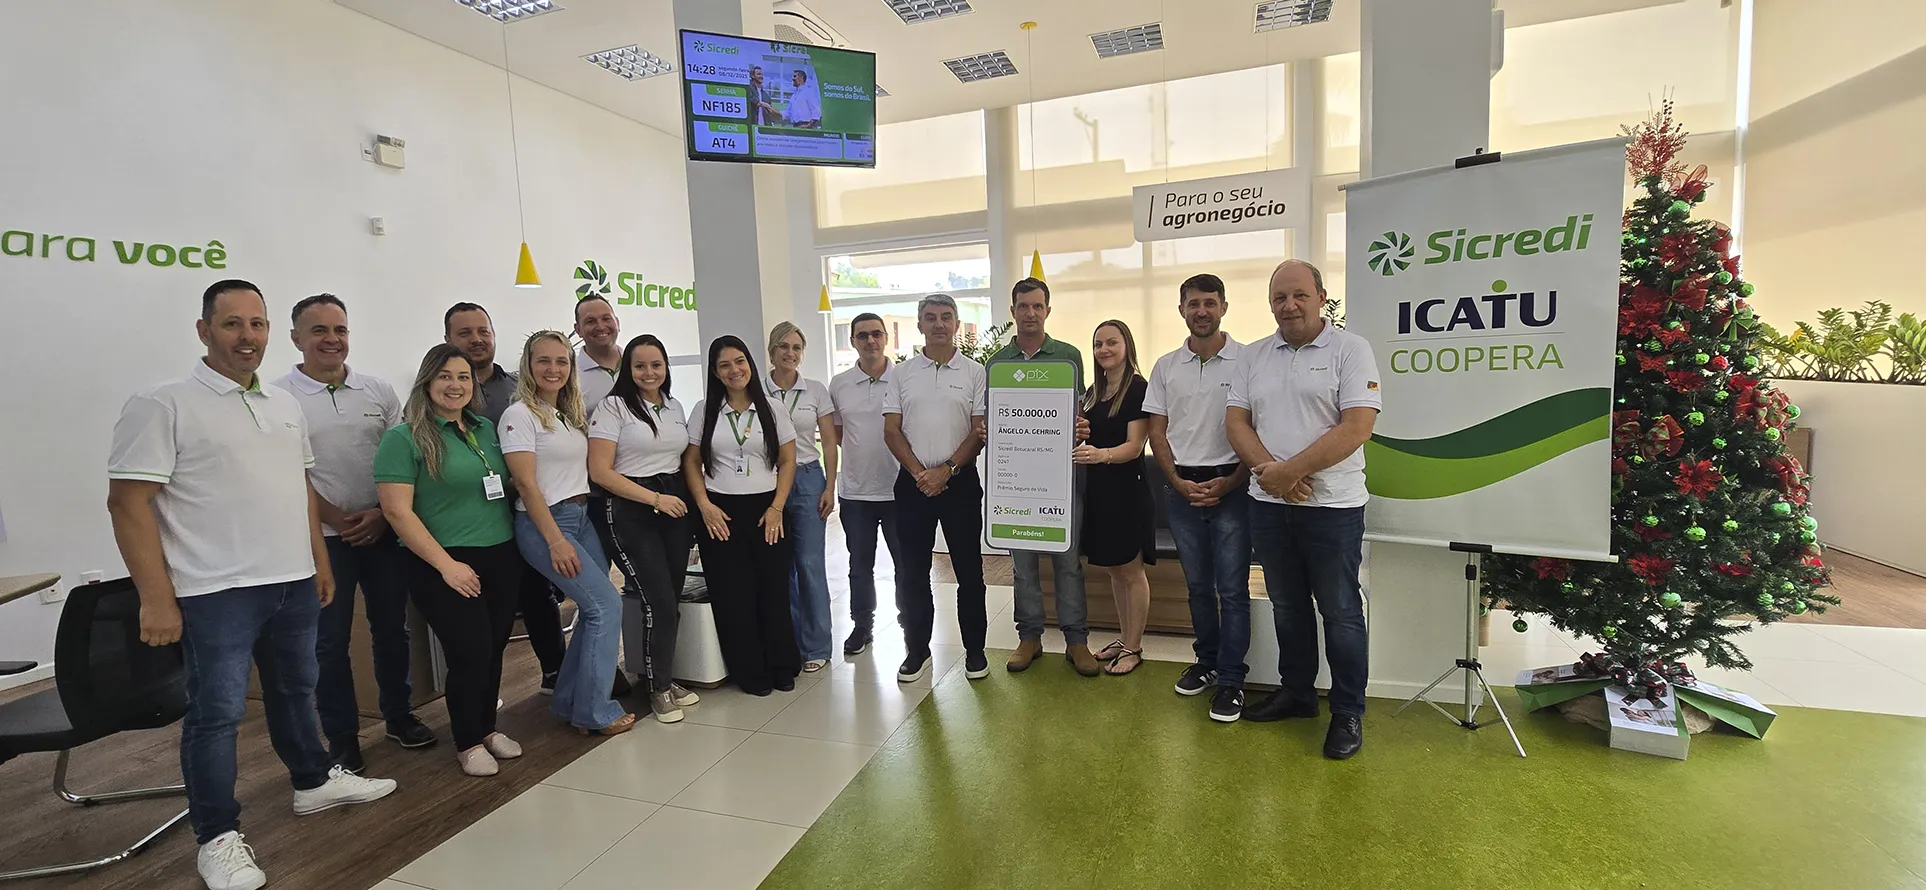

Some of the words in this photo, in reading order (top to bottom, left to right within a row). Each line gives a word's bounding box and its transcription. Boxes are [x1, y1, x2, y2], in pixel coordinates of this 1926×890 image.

[707, 42, 739, 55] Sicredi
[687, 64, 716, 75] 14:28
[824, 83, 844, 91] Somos
[702, 100, 741, 113] NF185
[712, 137, 736, 149] AT4
[1165, 192, 1207, 209] Para
[1213, 191, 1224, 203] o
[1229, 186, 1263, 202] seu
[1163, 200, 1286, 229] agronegócio
[1424, 213, 1594, 265] Sicredi
[1, 229, 96, 262] ara
[112, 239, 227, 269] você
[617, 271, 698, 311] Sicred
[1398, 280, 1557, 334] ICATU
[1390, 343, 1564, 374] COOPERA
[1027, 368, 1049, 382] pix
[998, 408, 1010, 418] R$
[1011, 408, 1058, 418] 50.000,00
[998, 426, 1024, 435] ÂNGELO
[1003, 507, 1032, 516] Sicredi
[1039, 505, 1065, 515] ICATU
[1012, 529, 1045, 537] Parabéns!
